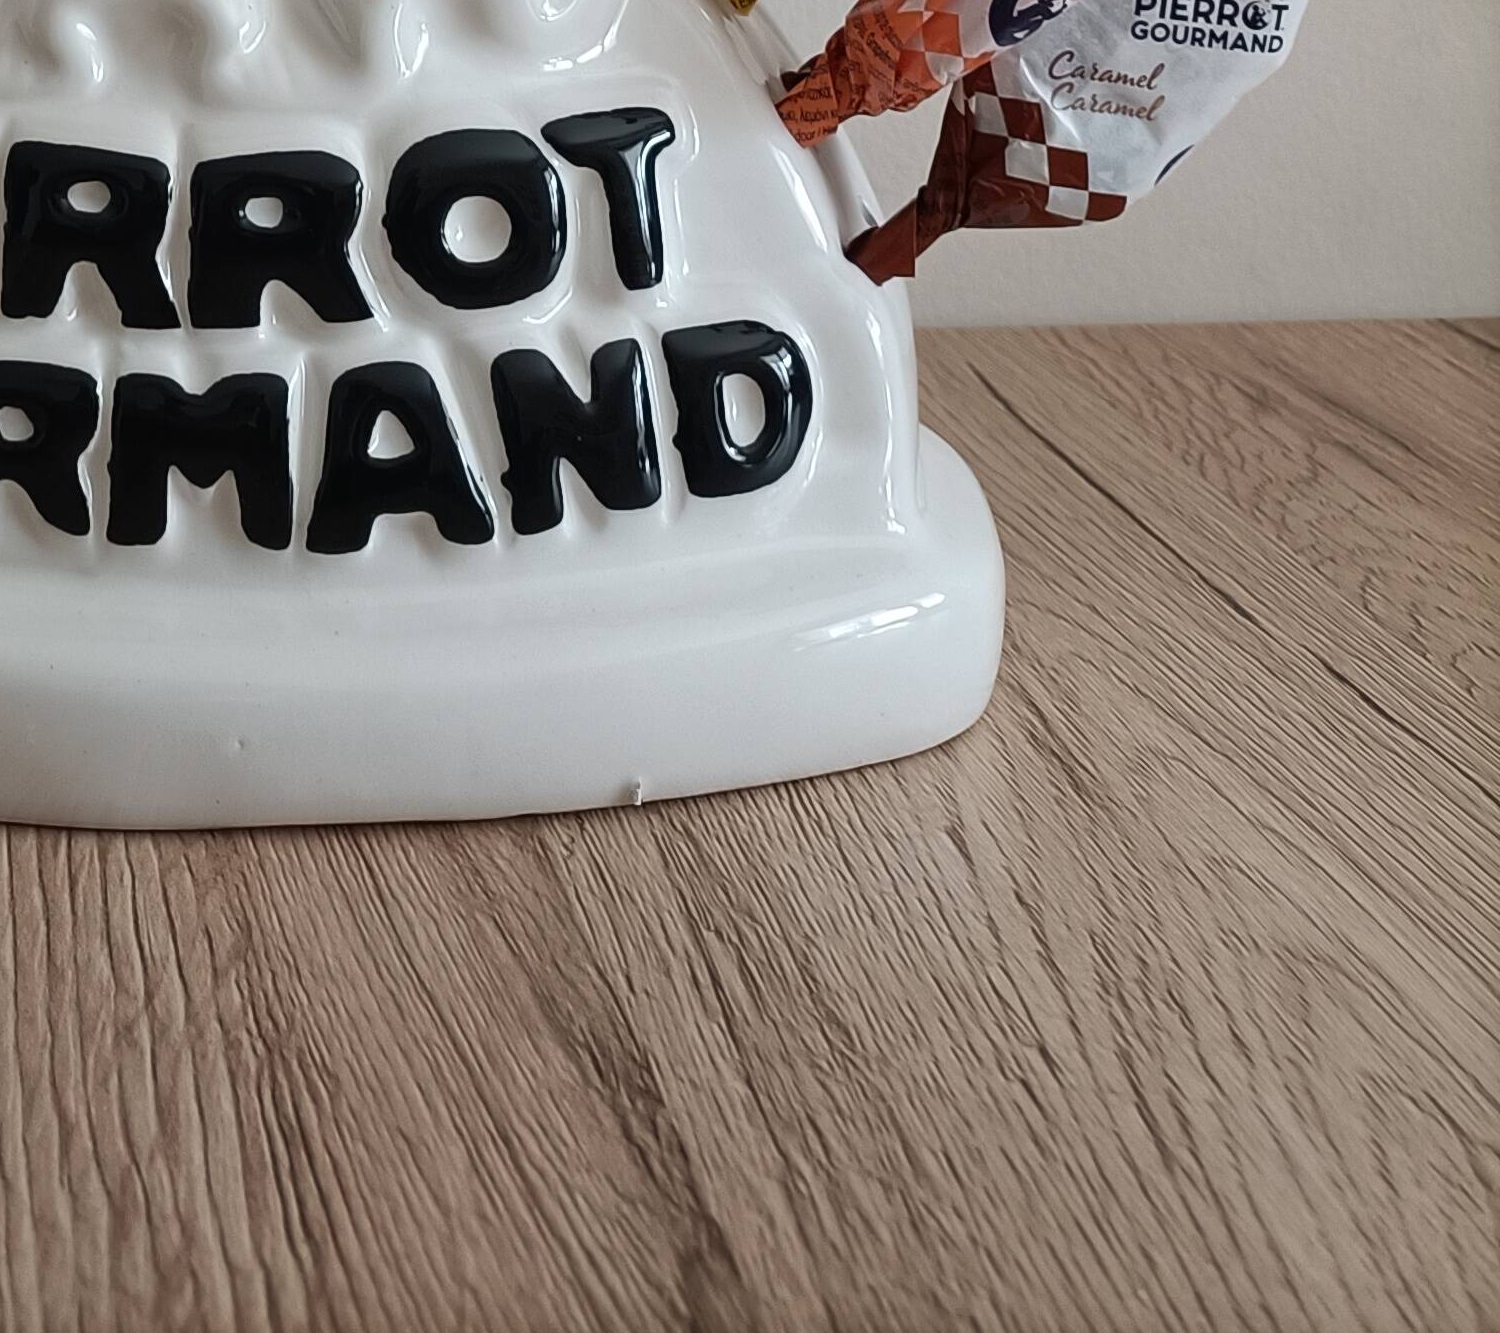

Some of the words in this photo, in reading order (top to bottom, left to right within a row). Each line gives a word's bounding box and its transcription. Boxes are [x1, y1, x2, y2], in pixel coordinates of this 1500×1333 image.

[1131, 20, 1284, 53] GOURMAND
[1048, 49, 1165, 90] Caramel
[1050, 82, 1165, 122] Caramel
